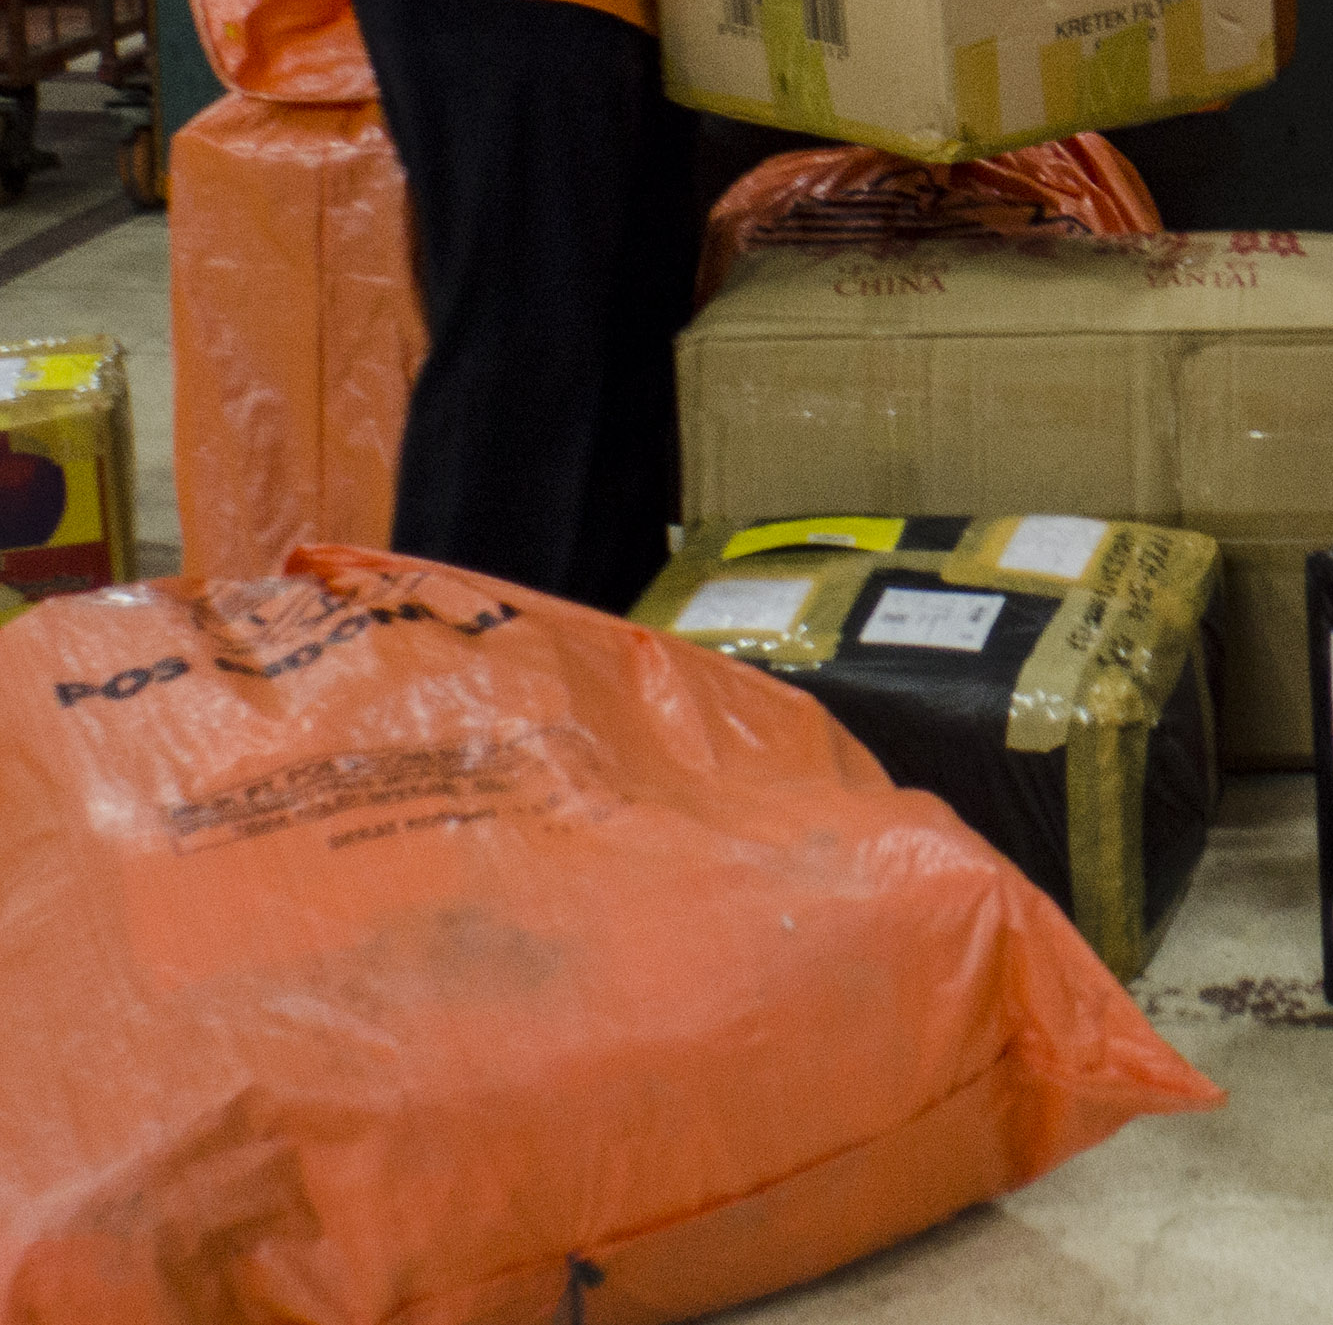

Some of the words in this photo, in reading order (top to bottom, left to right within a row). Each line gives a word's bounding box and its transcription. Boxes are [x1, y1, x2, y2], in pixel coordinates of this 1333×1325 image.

[1055, 9, 1127, 39] KRETEK
[833, 273, 948, 298] CHINA
[56, 655, 189, 708] POS
